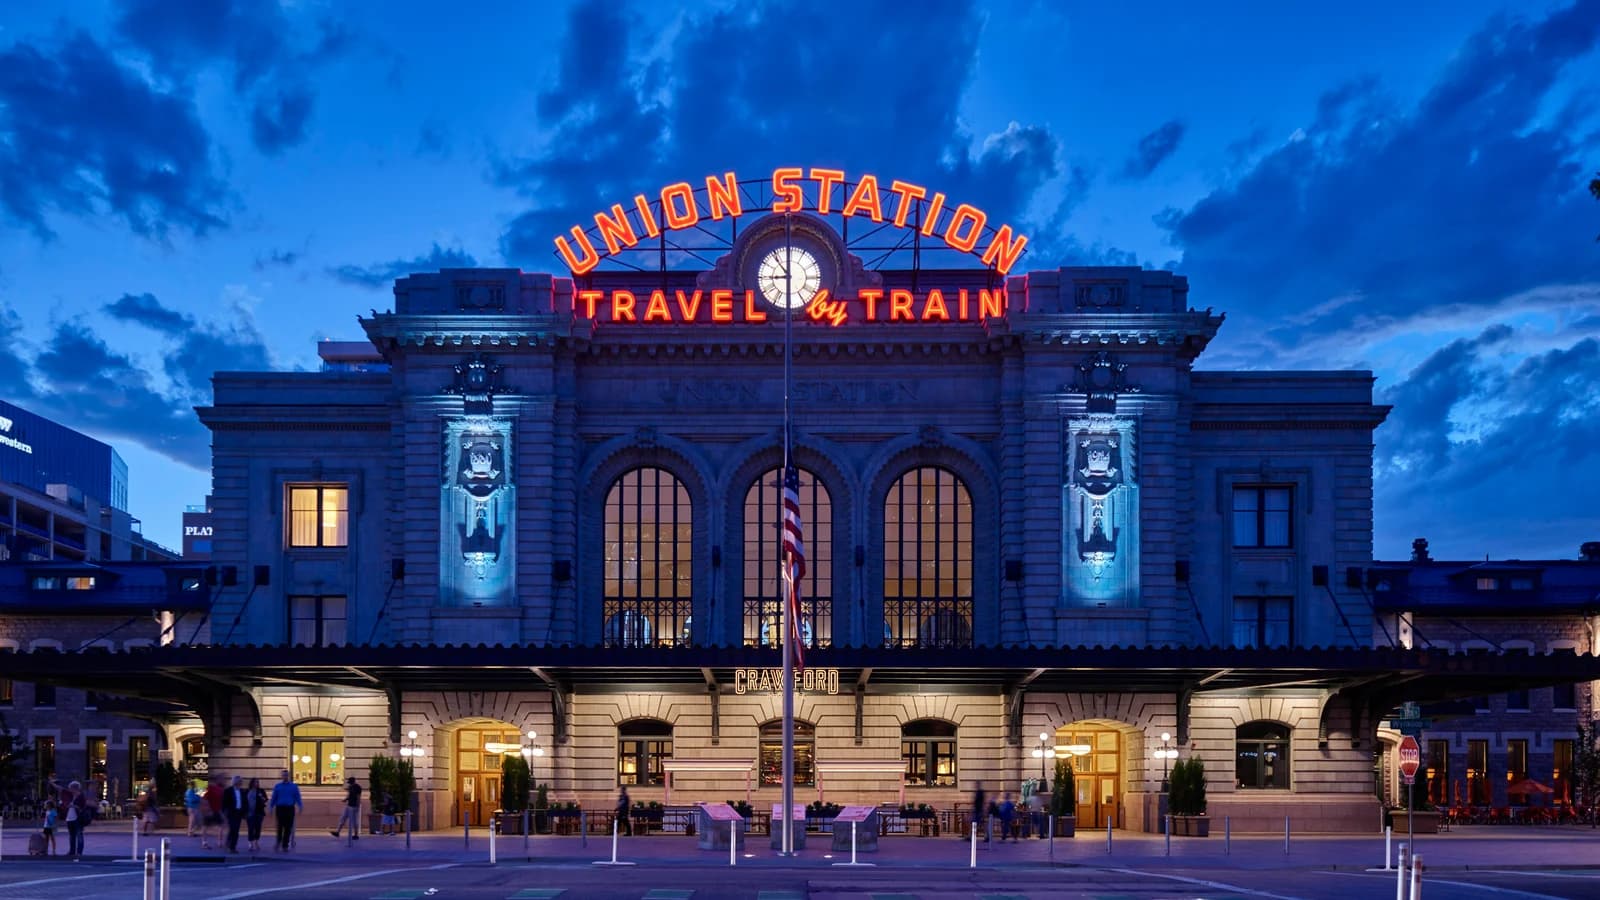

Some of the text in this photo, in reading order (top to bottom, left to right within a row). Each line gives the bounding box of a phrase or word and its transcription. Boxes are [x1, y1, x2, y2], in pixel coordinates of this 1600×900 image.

[555, 167, 1028, 275] UNION STATION
[578, 289, 1003, 327] TRAVEL by TRAIN
[657, 381, 920, 402] UNION STATION
[735, 669, 839, 694] CRAWFORD
[1401, 748, 1418, 761] STOP
